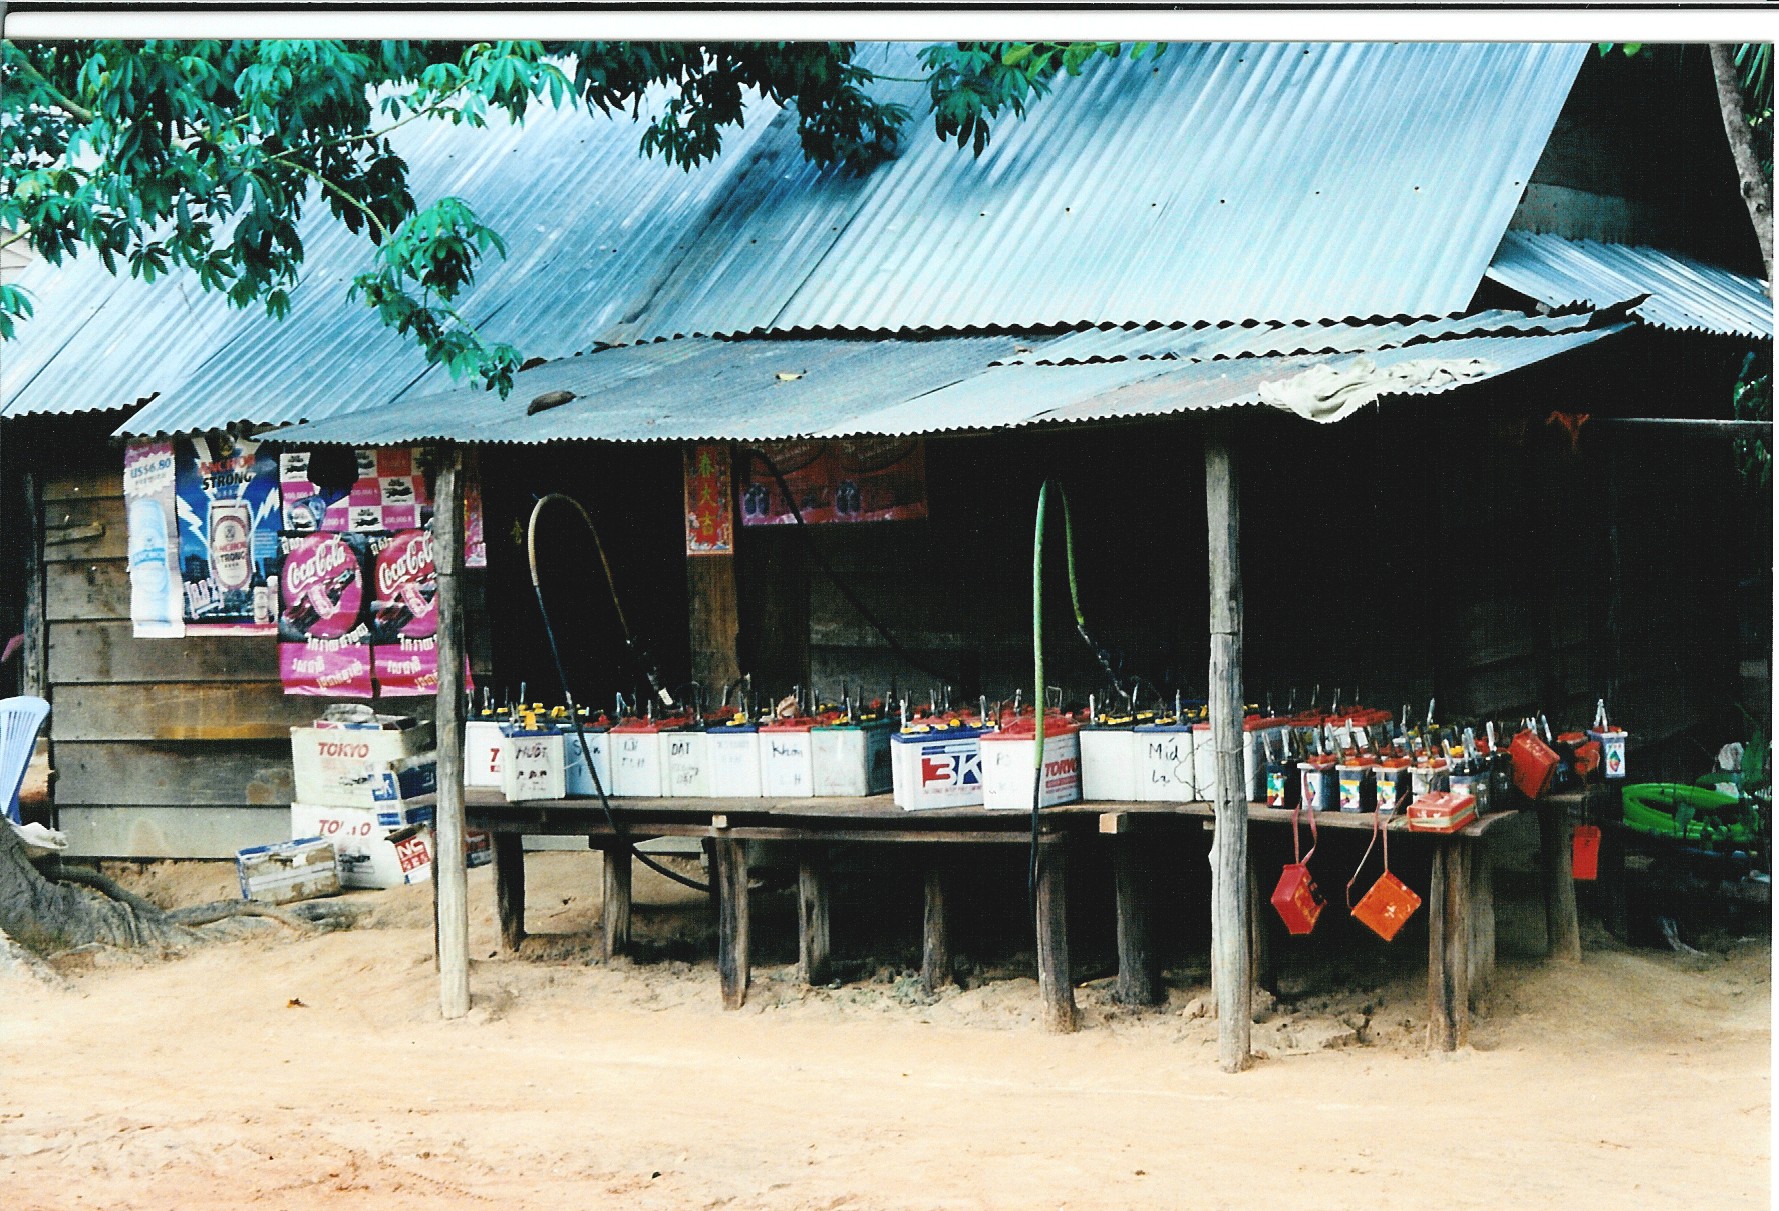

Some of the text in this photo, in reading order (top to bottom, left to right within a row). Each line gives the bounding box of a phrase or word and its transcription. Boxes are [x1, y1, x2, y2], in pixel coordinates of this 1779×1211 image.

[202, 471, 252, 490] STRONG
[287, 533, 346, 594] Coca-Cola
[379, 529, 433, 595] Coca-Col
[318, 742, 369, 758] TOKYO
